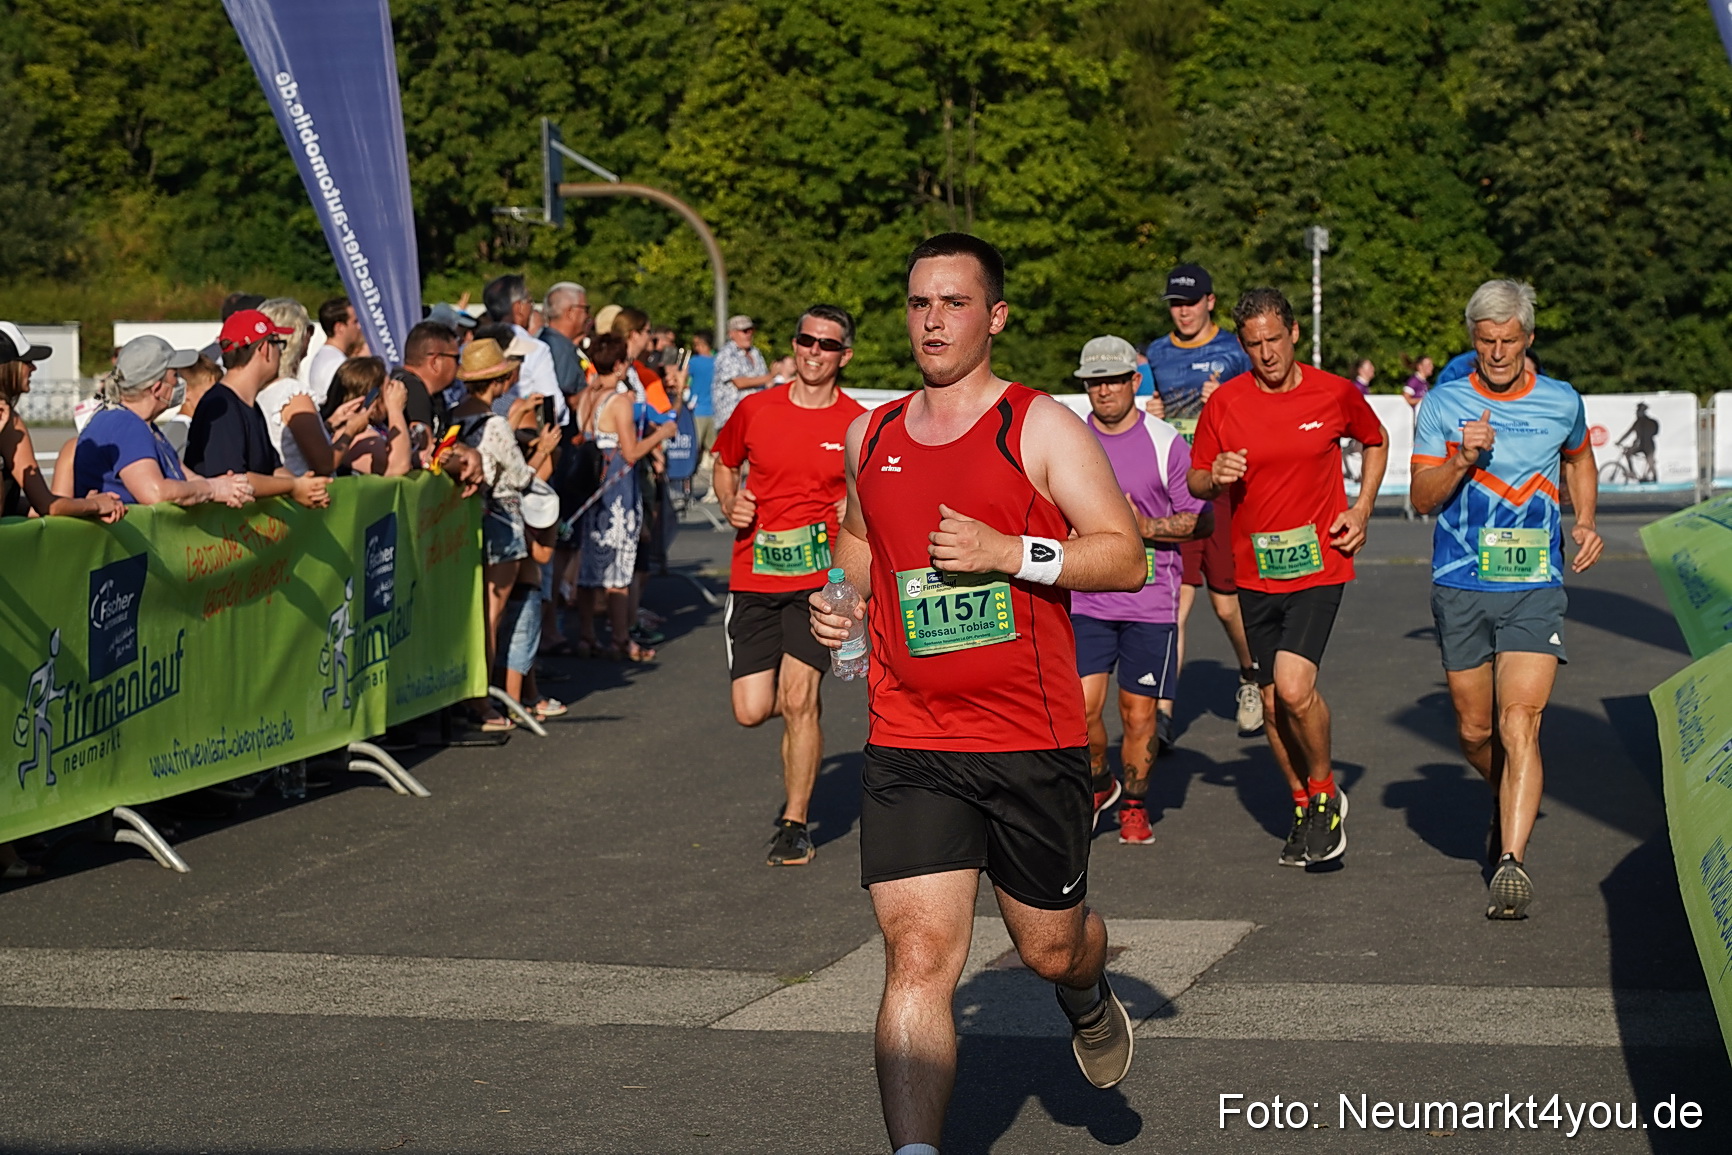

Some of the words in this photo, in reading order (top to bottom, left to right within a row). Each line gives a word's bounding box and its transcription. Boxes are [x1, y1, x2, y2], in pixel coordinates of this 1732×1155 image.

[762, 545, 802, 562] 1681
[1265, 544, 1310, 564] 1723
[1504, 547, 1527, 564] 10
[916, 590, 991, 626] 1157
[994, 591, 1009, 631] 2022
[905, 609, 917, 640] RUN
[918, 626, 957, 639] Sossau
[959, 619, 996, 633] Tobias
[63, 627, 185, 746] firmenlauf
[63, 728, 121, 774] neumarkt
